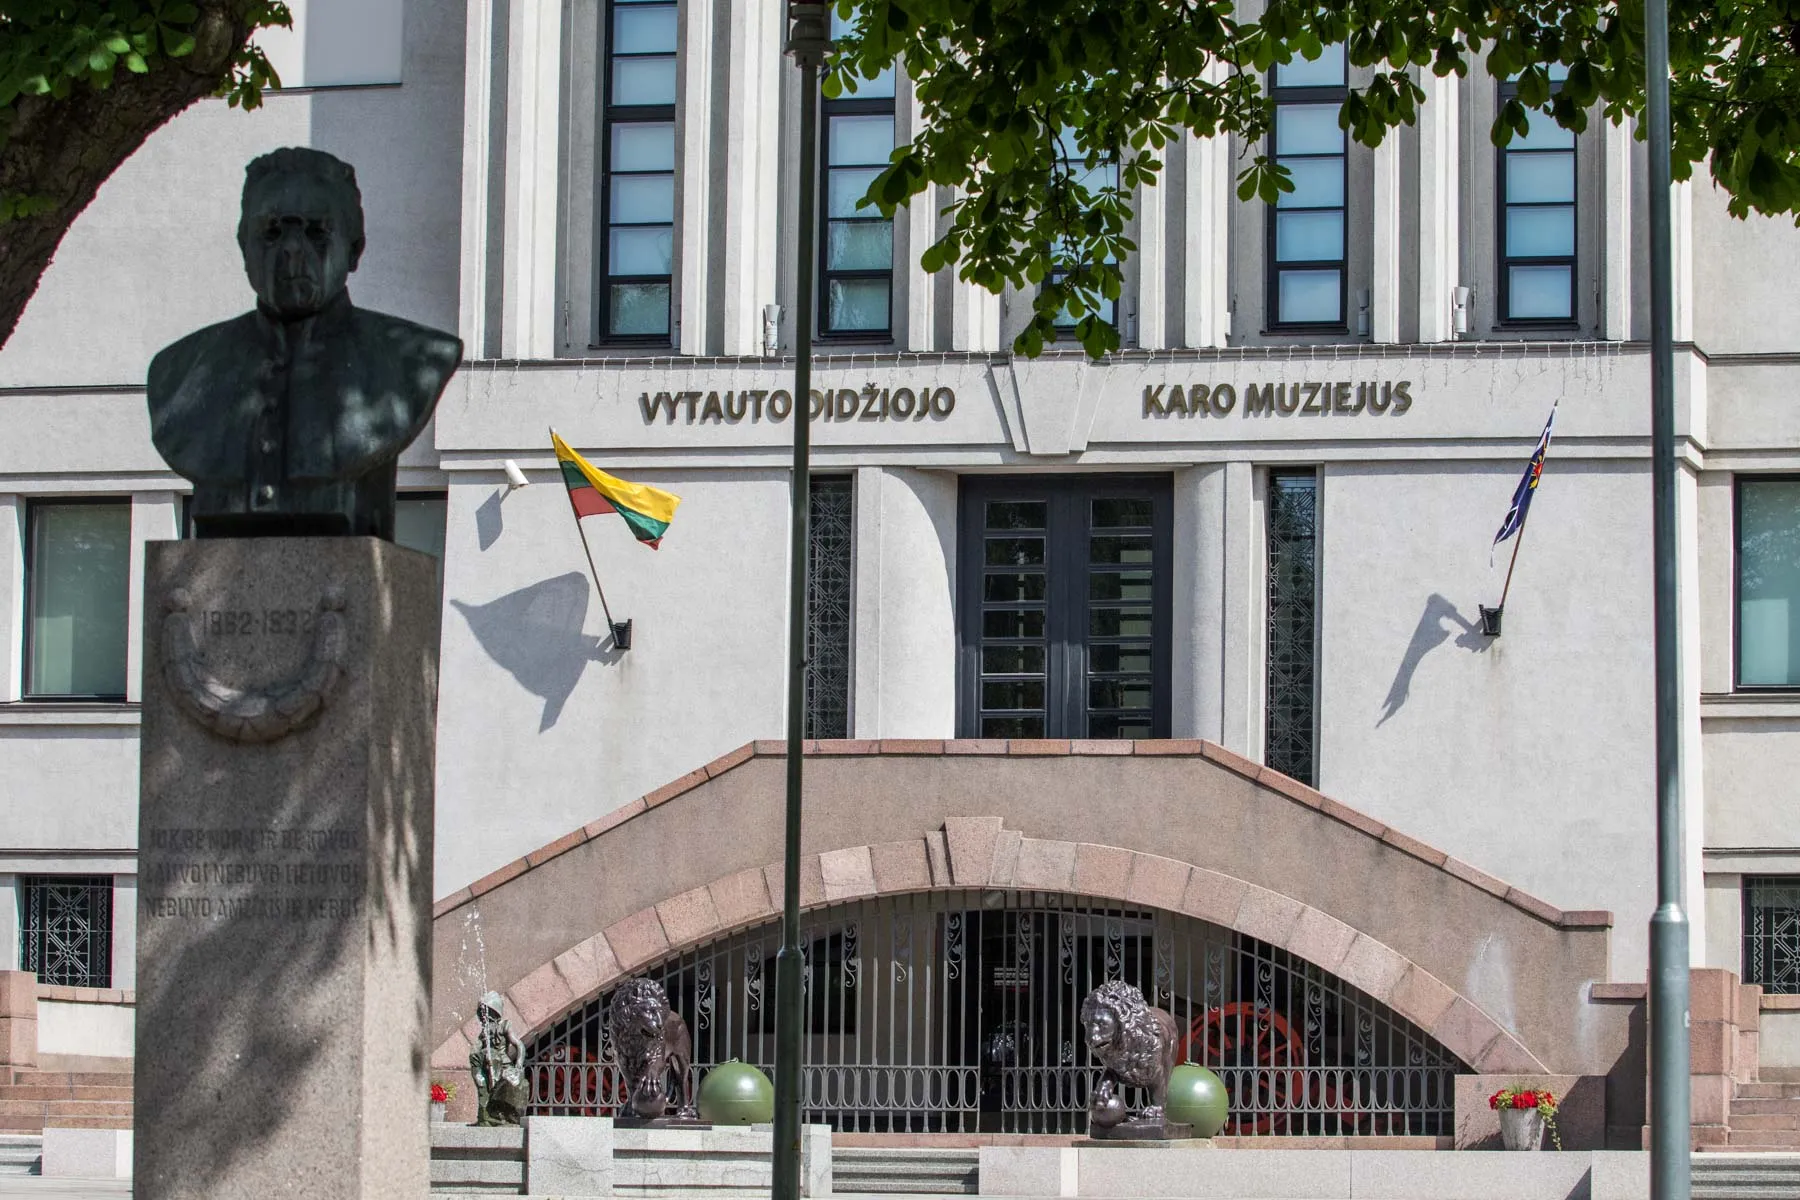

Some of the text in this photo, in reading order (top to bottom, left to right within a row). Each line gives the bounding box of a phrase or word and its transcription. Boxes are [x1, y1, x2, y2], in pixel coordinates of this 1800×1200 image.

[640, 389, 793, 421] VYTAUTO
[1145, 381, 1413, 415] KARO MUZIEJUS
[145, 897, 211, 918] NEBUVO
